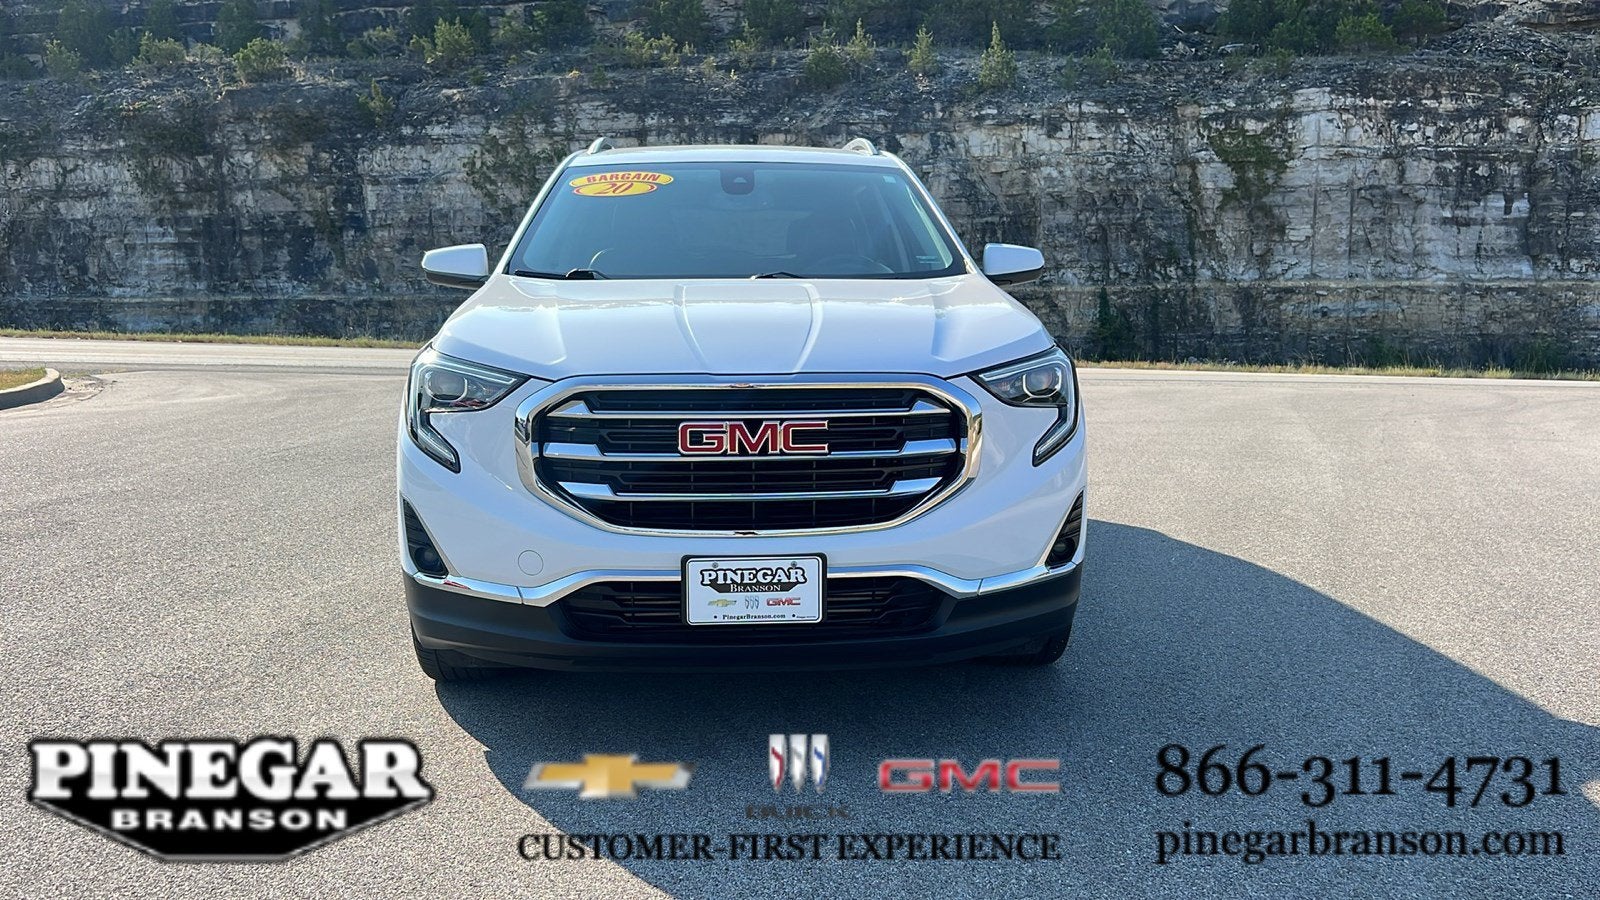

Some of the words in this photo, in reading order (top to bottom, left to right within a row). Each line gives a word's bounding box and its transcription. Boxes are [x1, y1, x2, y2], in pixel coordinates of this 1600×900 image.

[587, 173, 661, 183] BARGAIN
[593, 182, 634, 194] 20
[678, 420, 829, 455] GMC
[701, 567, 807, 586] PINEGAR
[766, 597, 801, 607] GMC
